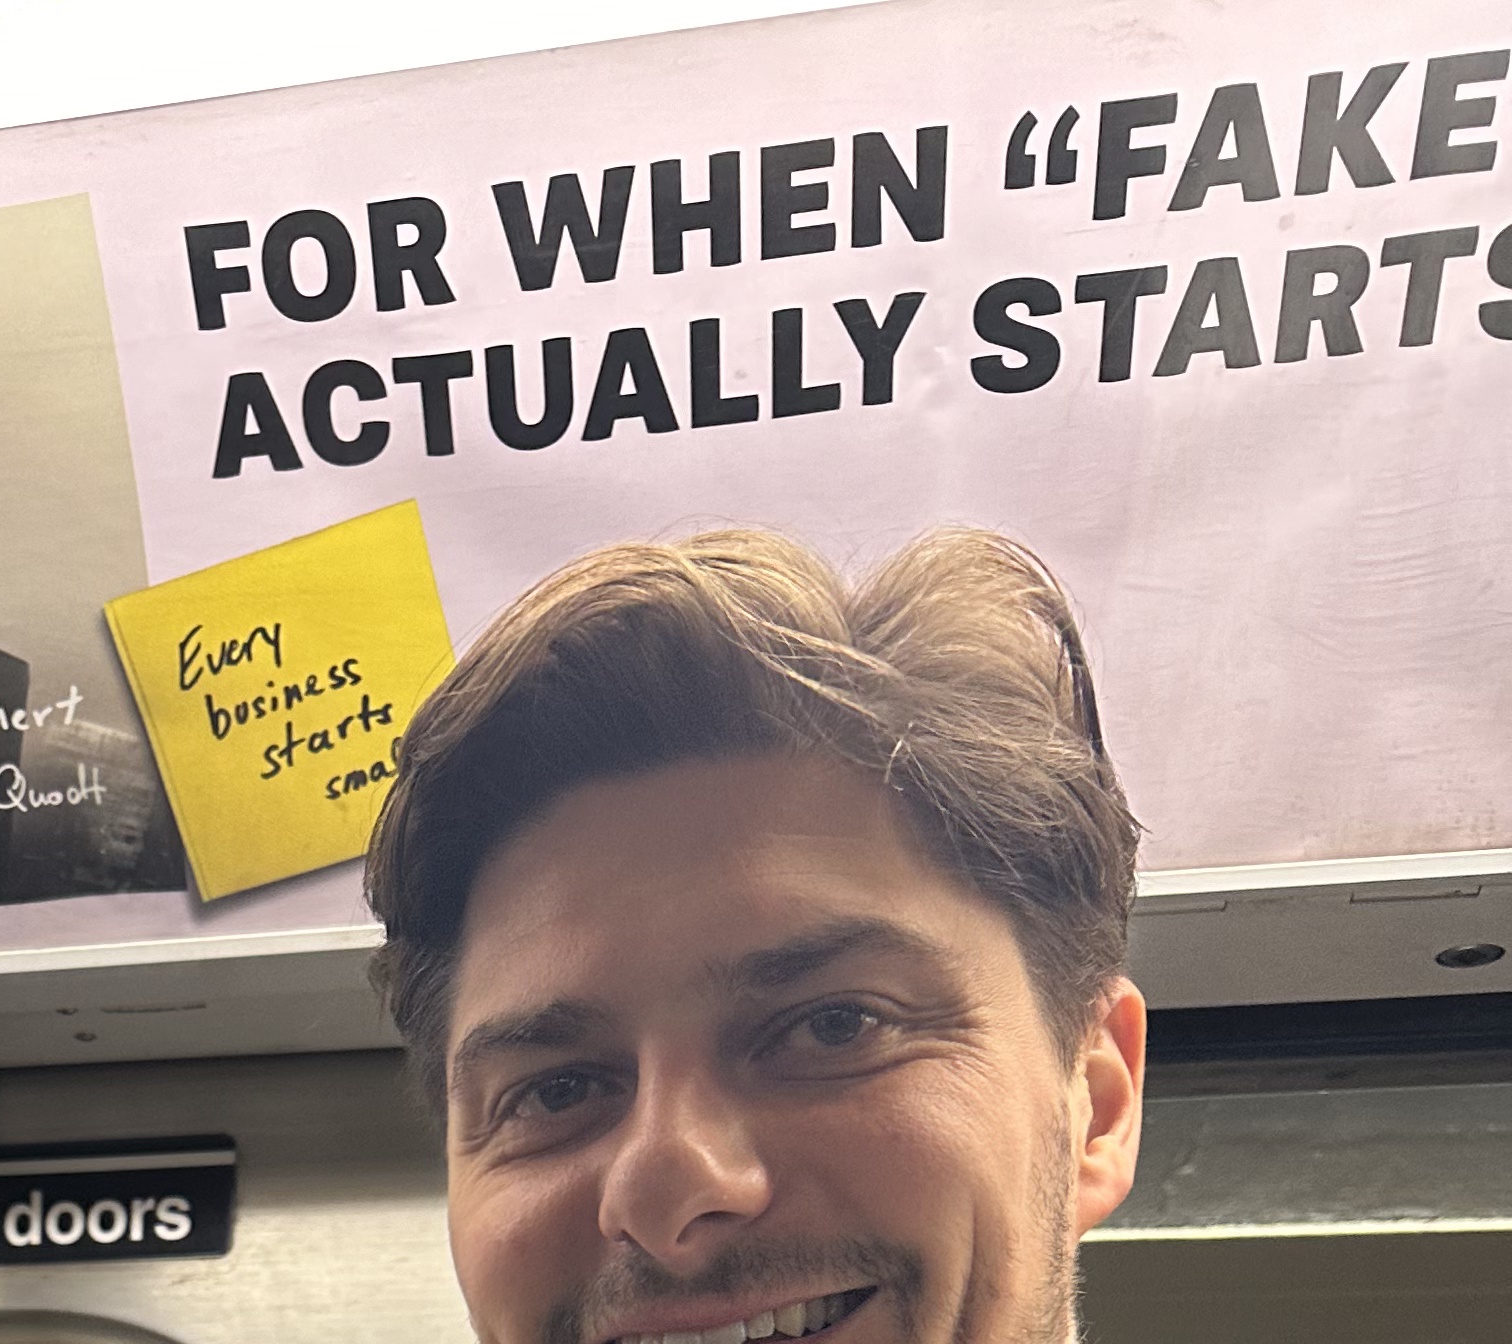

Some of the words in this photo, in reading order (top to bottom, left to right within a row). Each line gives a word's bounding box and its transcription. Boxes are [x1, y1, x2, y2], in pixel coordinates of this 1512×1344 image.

[183, 196, 458, 331] FOR
[491, 125, 948, 290] WHEN
[212, 292, 927, 479] ACTUALLY
[179, 622, 281, 691] Every
[204, 657, 362, 740] business
[260, 693, 393, 780] starts
[3, 1189, 193, 1247] doors
